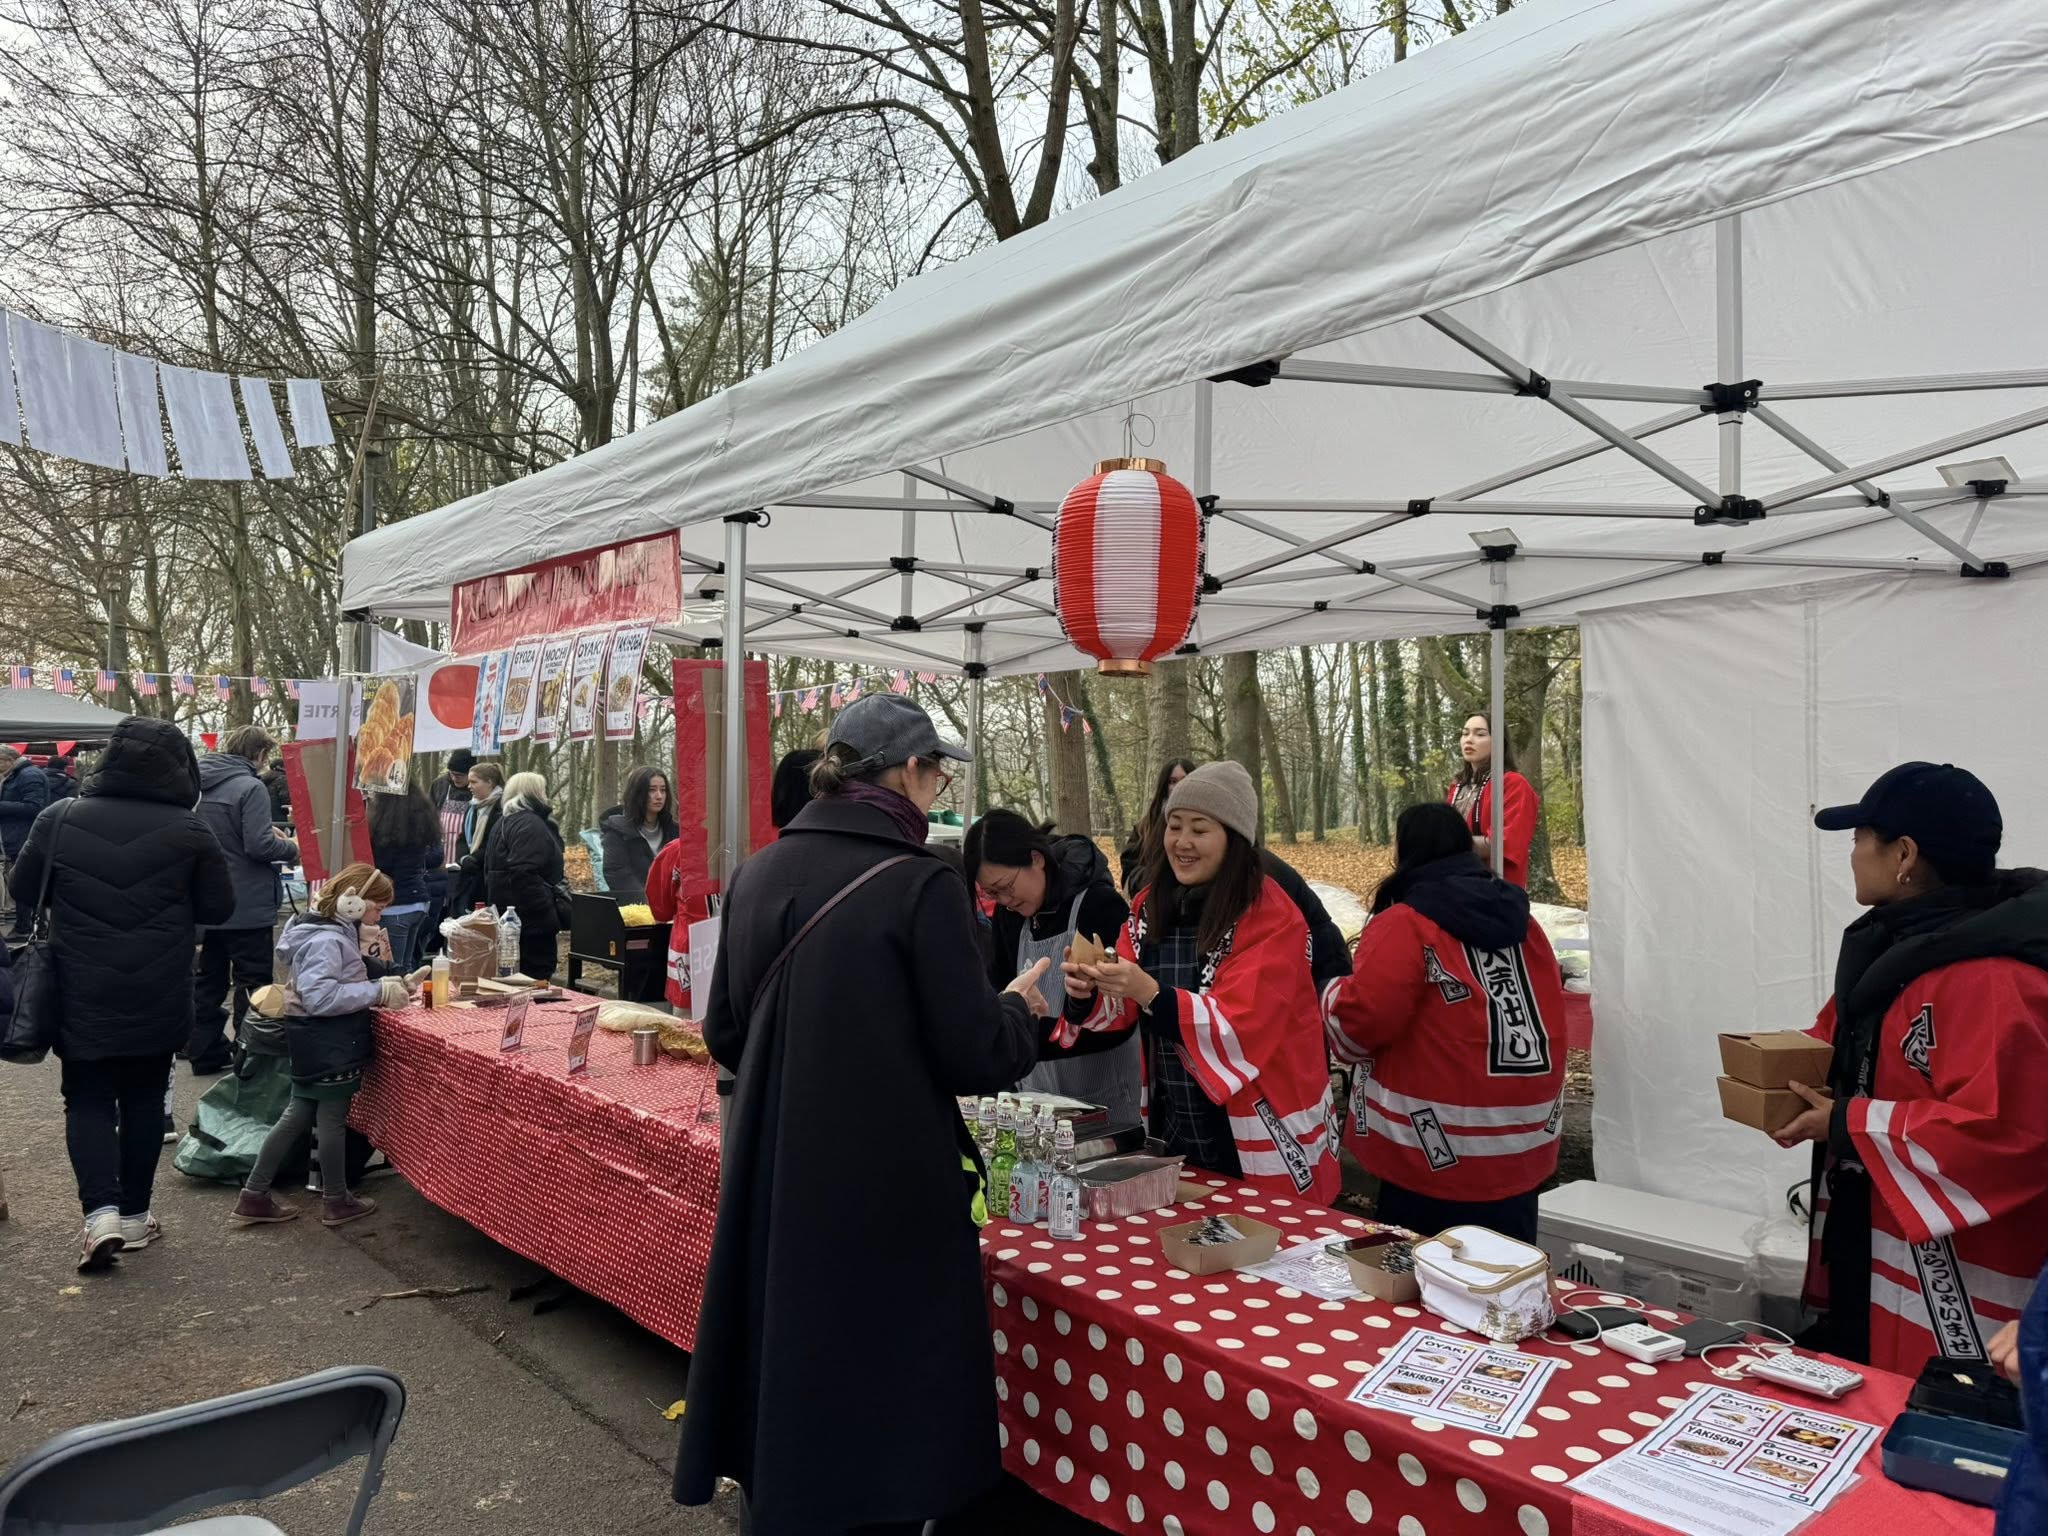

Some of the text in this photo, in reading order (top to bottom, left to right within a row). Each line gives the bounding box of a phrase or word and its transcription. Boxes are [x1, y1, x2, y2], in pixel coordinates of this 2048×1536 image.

[514, 650, 535, 665] GYOZA
[544, 647, 569, 663] MOCHI
[578, 641, 602, 658] OYAKI
[1420, 1117, 1449, 1160] 大入
[1425, 1340, 1468, 1355] OYAKI
[1487, 1354, 1531, 1368] MOCHI
[1396, 1368, 1446, 1386] YAKISOBA
[1461, 1384, 1509, 1401] GYOZA
[1721, 1399, 1771, 1415] OYAKI
[1795, 1417, 1846, 1434] MOCHI
[1687, 1425, 1745, 1449] YAKISOBA
[1763, 1448, 1819, 1470] GYOZA
